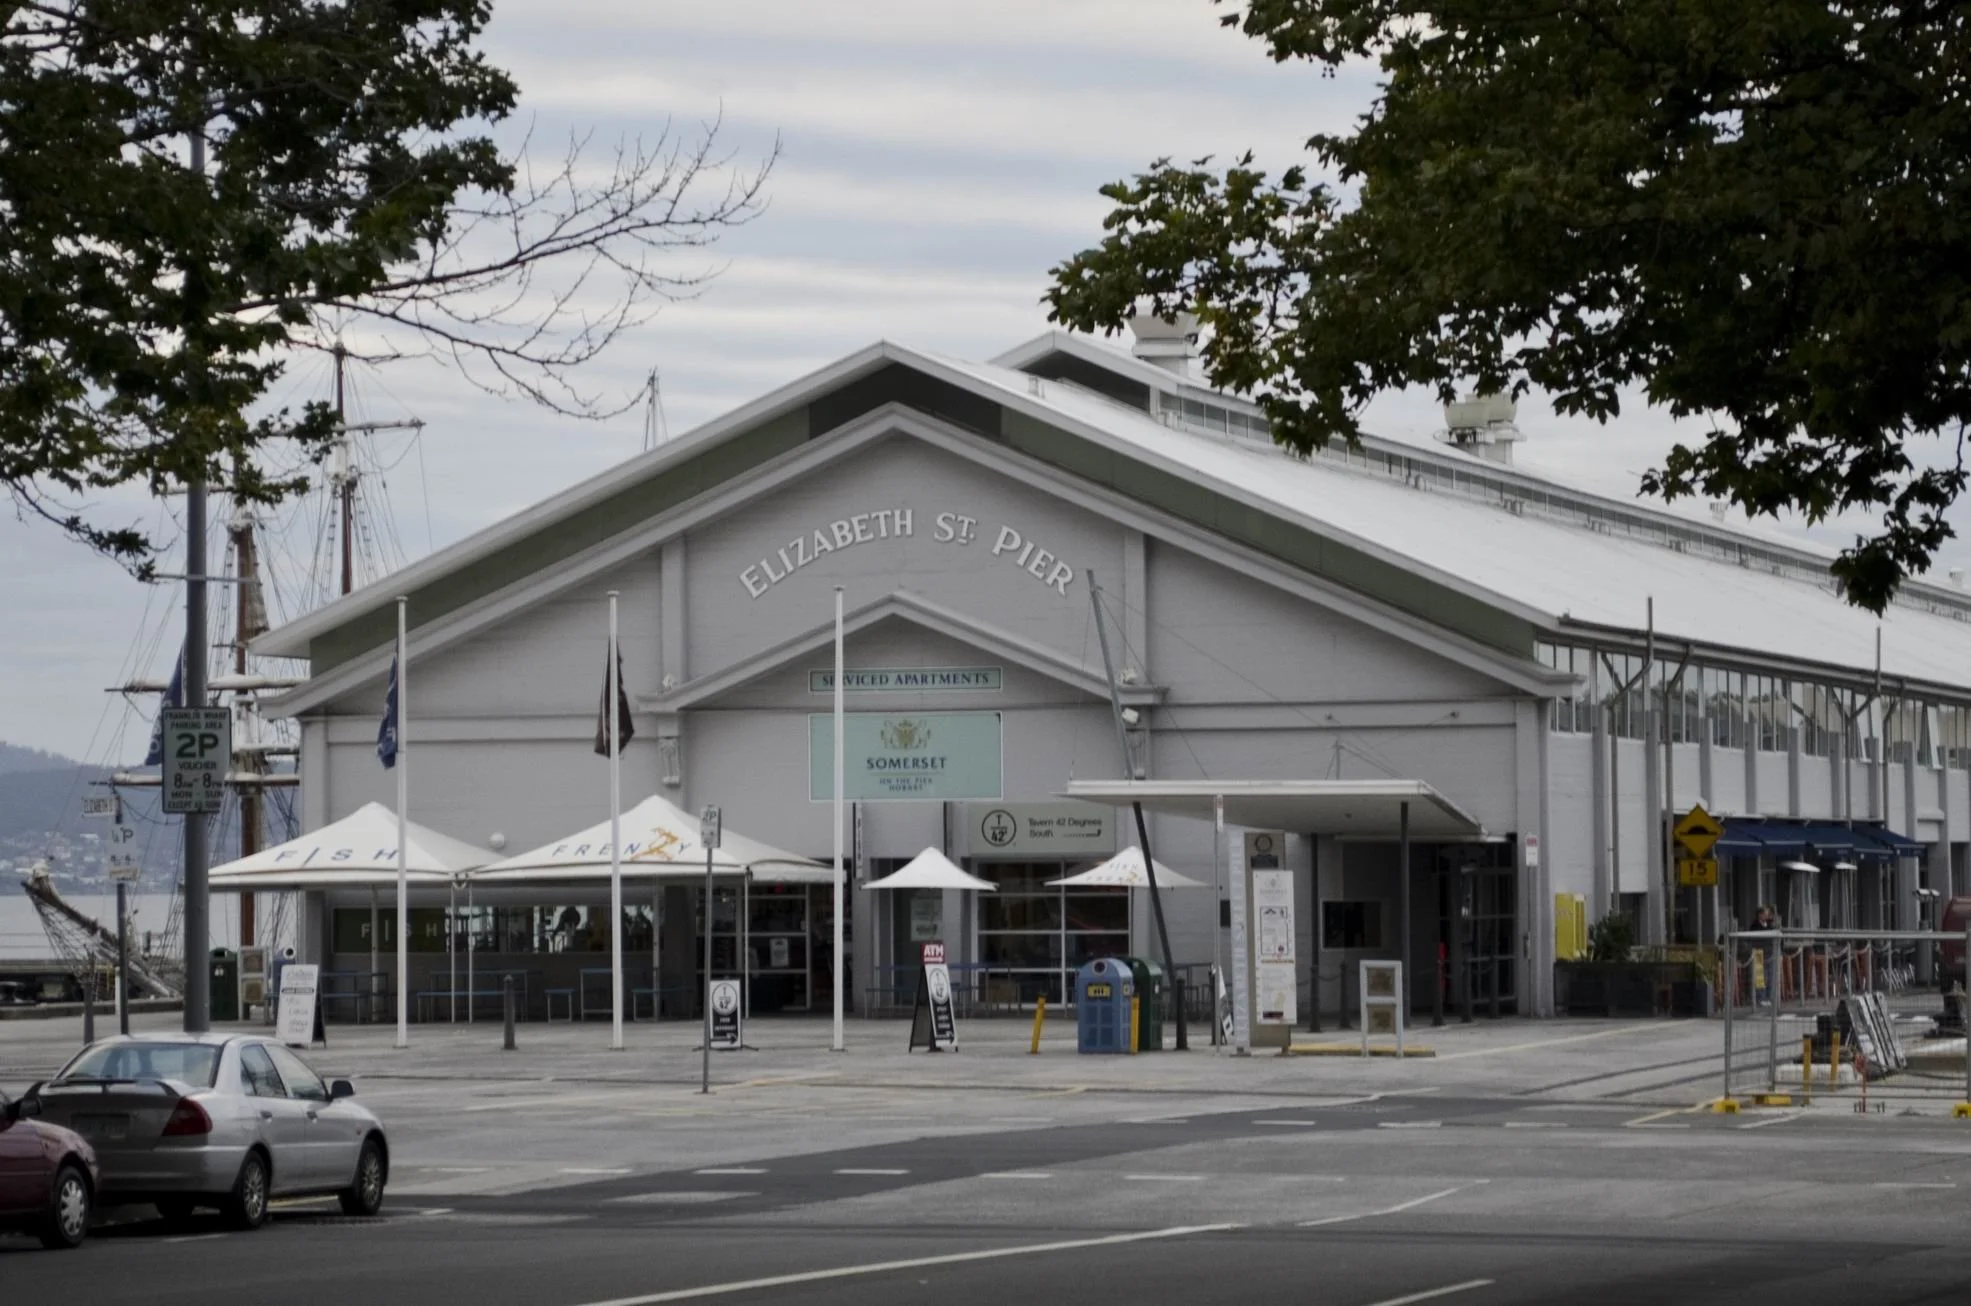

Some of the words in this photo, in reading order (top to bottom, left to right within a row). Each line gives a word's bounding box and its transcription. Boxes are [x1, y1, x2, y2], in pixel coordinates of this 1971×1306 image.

[739, 508, 913, 599] ELIZABETH
[991, 524, 1074, 596] PIER
[894, 672, 990, 686] APARTMENTS
[170, 721, 201, 729] PARKING
[205, 721, 223, 729] AREA
[175, 732, 219, 758] 2P
[178, 761, 217, 770] VOUCHER
[866, 756, 947, 770] SOMERSET
[888, 784, 923, 792] HOBART
[171, 790, 193, 799] MON
[1028, 817, 1054, 826] Tavern
[1056, 817, 1066, 826] 42
[1068, 816, 1102, 828] Degrees
[1029, 829, 1054, 838] South
[1690, 861, 1708, 877] 15
[923, 944, 945, 957] ATM
